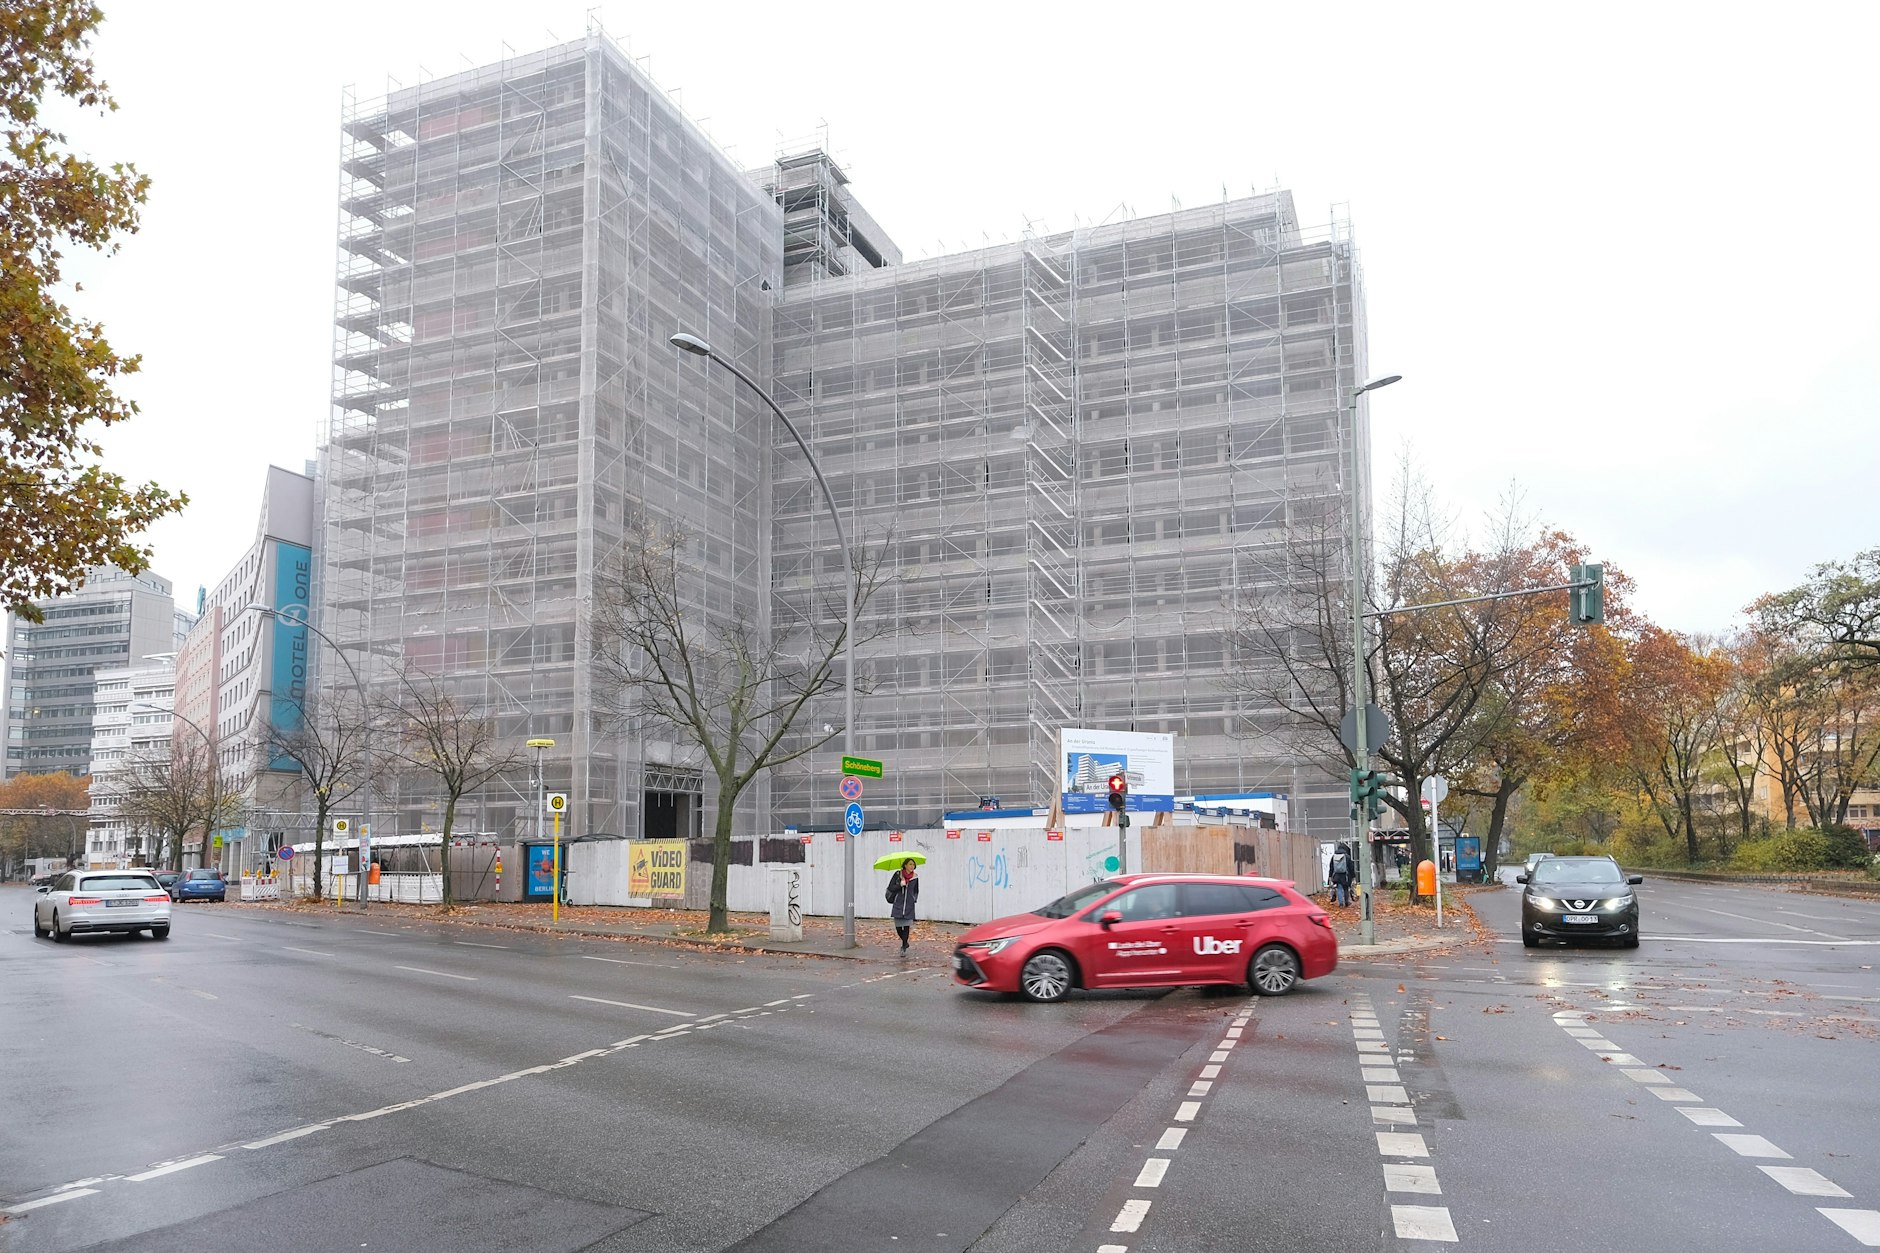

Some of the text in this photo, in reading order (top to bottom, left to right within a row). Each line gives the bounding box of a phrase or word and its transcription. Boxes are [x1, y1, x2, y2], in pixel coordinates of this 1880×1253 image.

[845, 760, 880, 774] Schöneberg
[651, 871, 682, 889] GUARD
[1193, 936, 1243, 955] Uber
